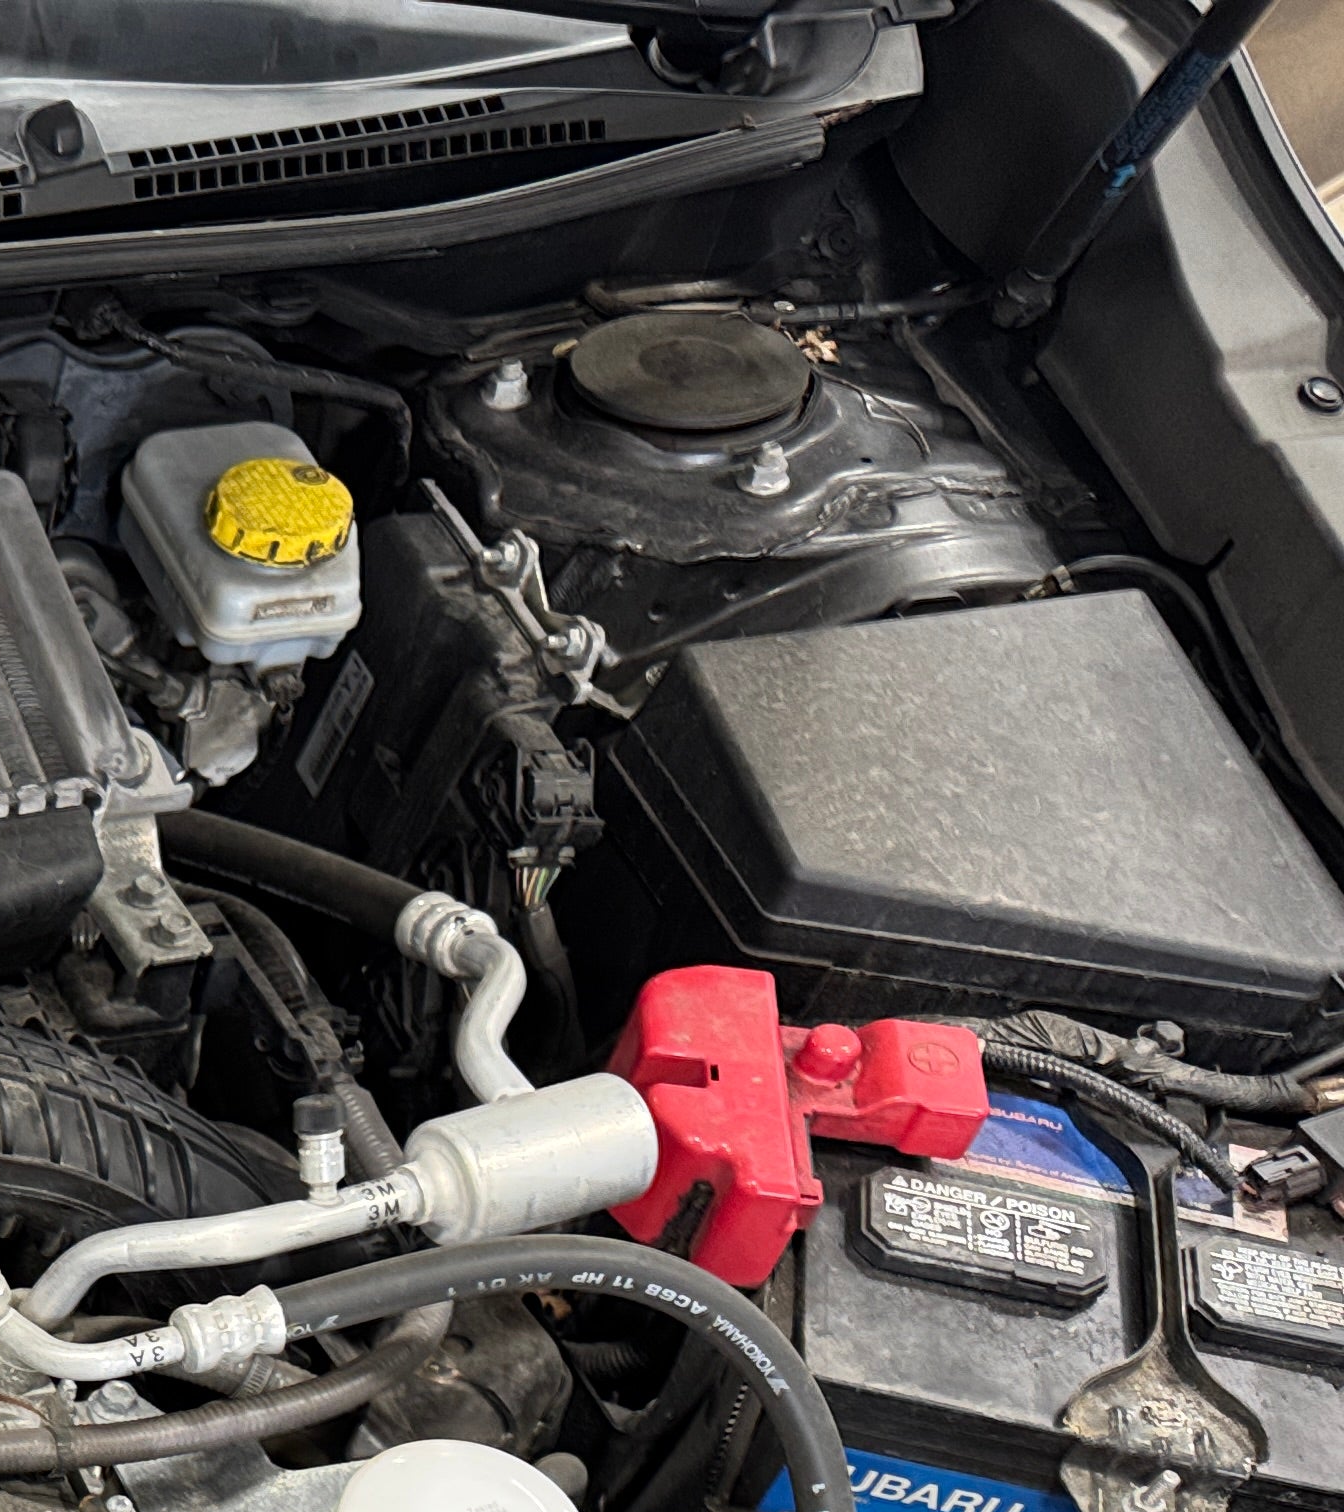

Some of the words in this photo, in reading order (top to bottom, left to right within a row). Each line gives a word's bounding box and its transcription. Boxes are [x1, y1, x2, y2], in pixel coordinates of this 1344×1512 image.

[910, 1178, 987, 1206] DANGER
[1006, 1199, 1076, 1223] POISON
[519, 1271, 553, 1285] AK
[570, 1271, 605, 1286] HP
[612, 1275, 635, 1290] 11
[713, 1315, 777, 1378] YOKOHAMA
